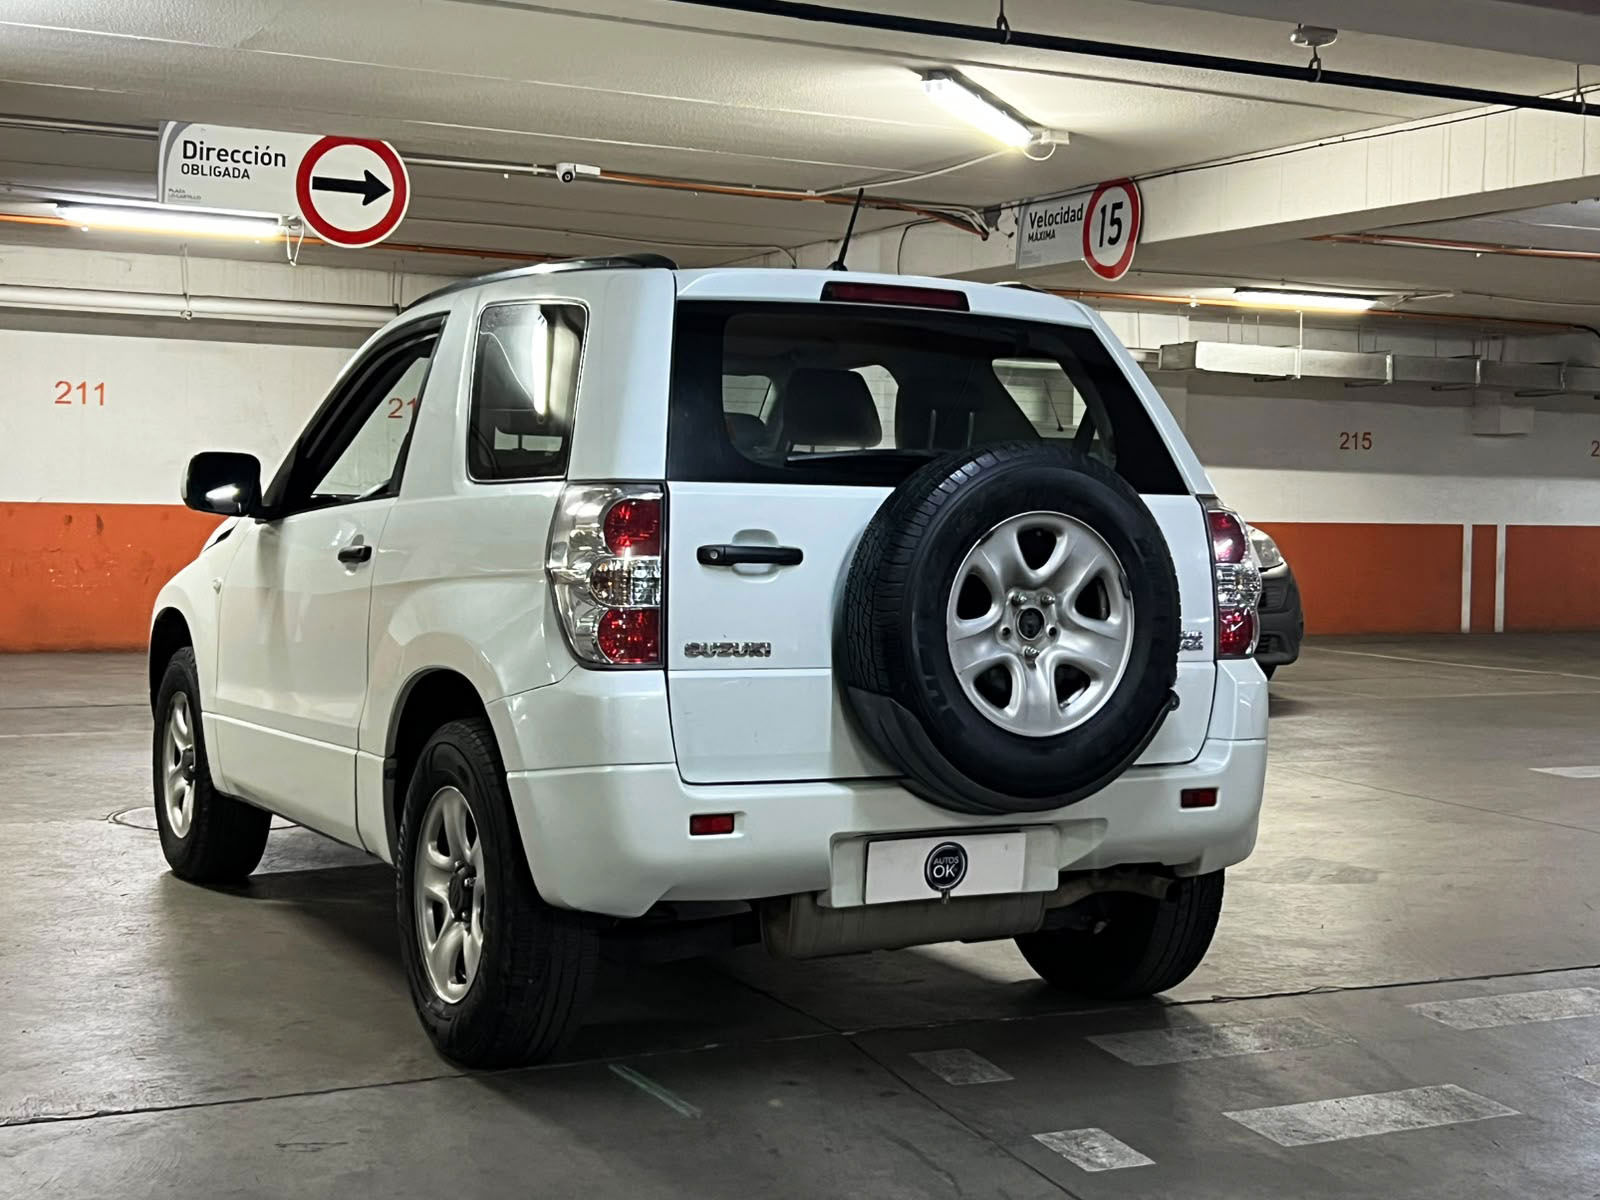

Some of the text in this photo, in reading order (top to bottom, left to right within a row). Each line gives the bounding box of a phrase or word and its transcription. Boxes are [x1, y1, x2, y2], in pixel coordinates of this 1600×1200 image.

[182, 139, 287, 168] Dirección
[180, 162, 251, 180] OBLIGADA
[1029, 202, 1084, 229] Velocidad
[1098, 201, 1124, 248] 15
[54, 380, 105, 406] 211
[387, 397, 418, 419] 21
[1339, 431, 1373, 450] 215
[684, 641, 772, 658] SUZUKI
[933, 855, 960, 865] AUTOS
[933, 863, 956, 878] OK
